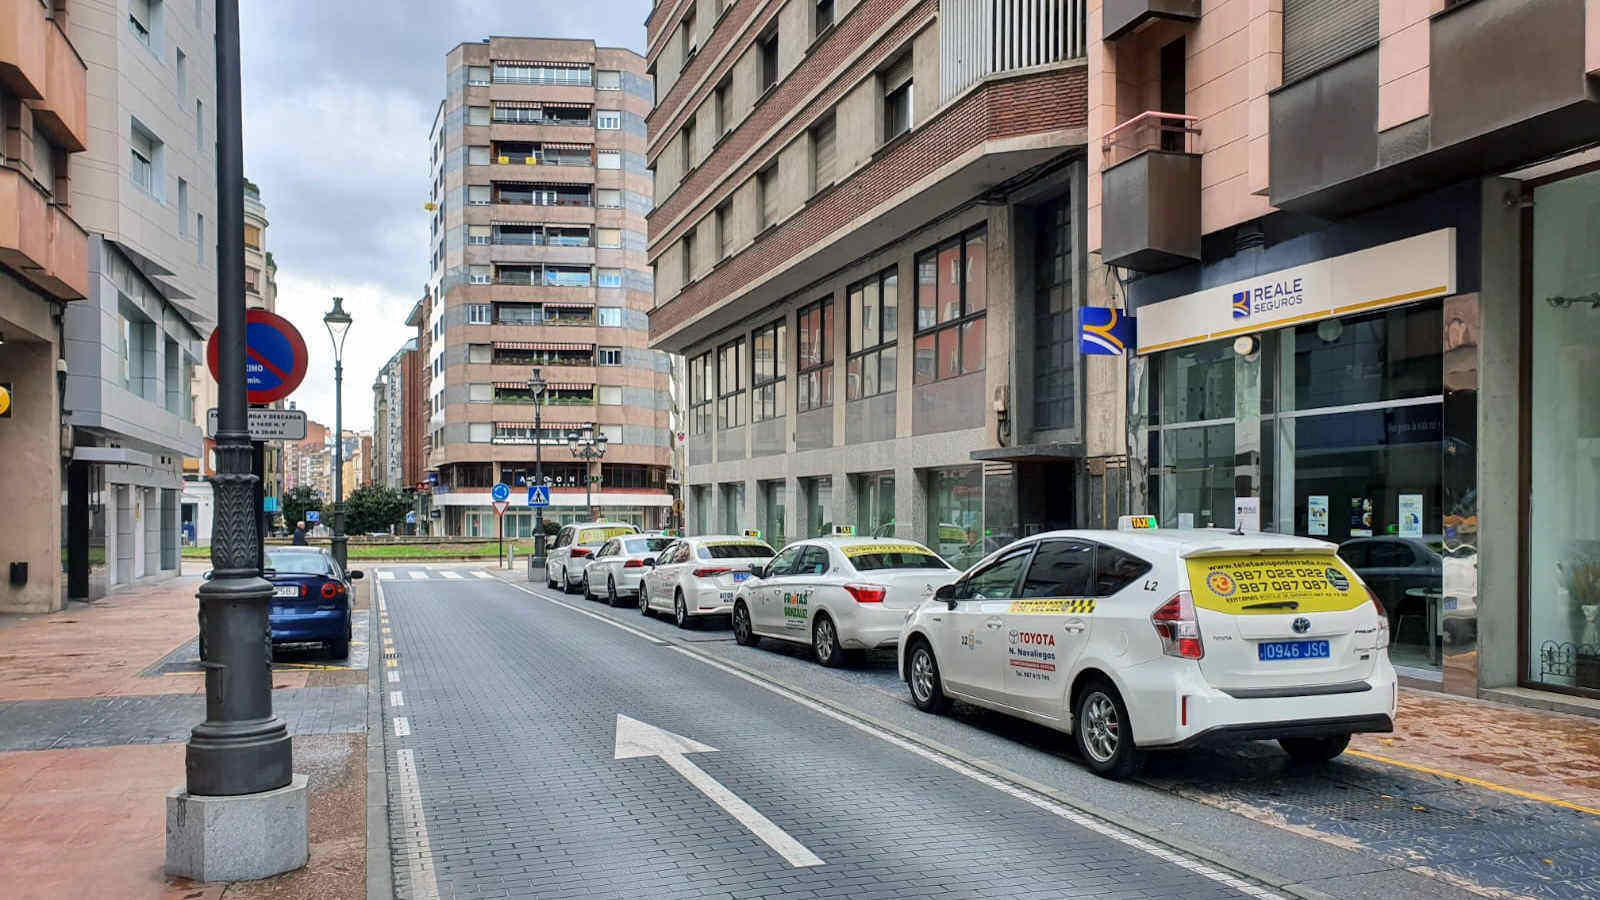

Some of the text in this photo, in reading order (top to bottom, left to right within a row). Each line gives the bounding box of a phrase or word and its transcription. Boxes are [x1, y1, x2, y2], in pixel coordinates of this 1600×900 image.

[1253, 278, 1303, 301] REALE
[1253, 294, 1304, 313] SEGUROS
[1132, 517, 1149, 528] TAXI
[1233, 568, 1325, 581] 987 022 022
[1239, 579, 1329, 593] 987 087 087
[1019, 632, 1055, 646] TOYOTA
[1265, 642, 1328, 659] 0946 JSC
